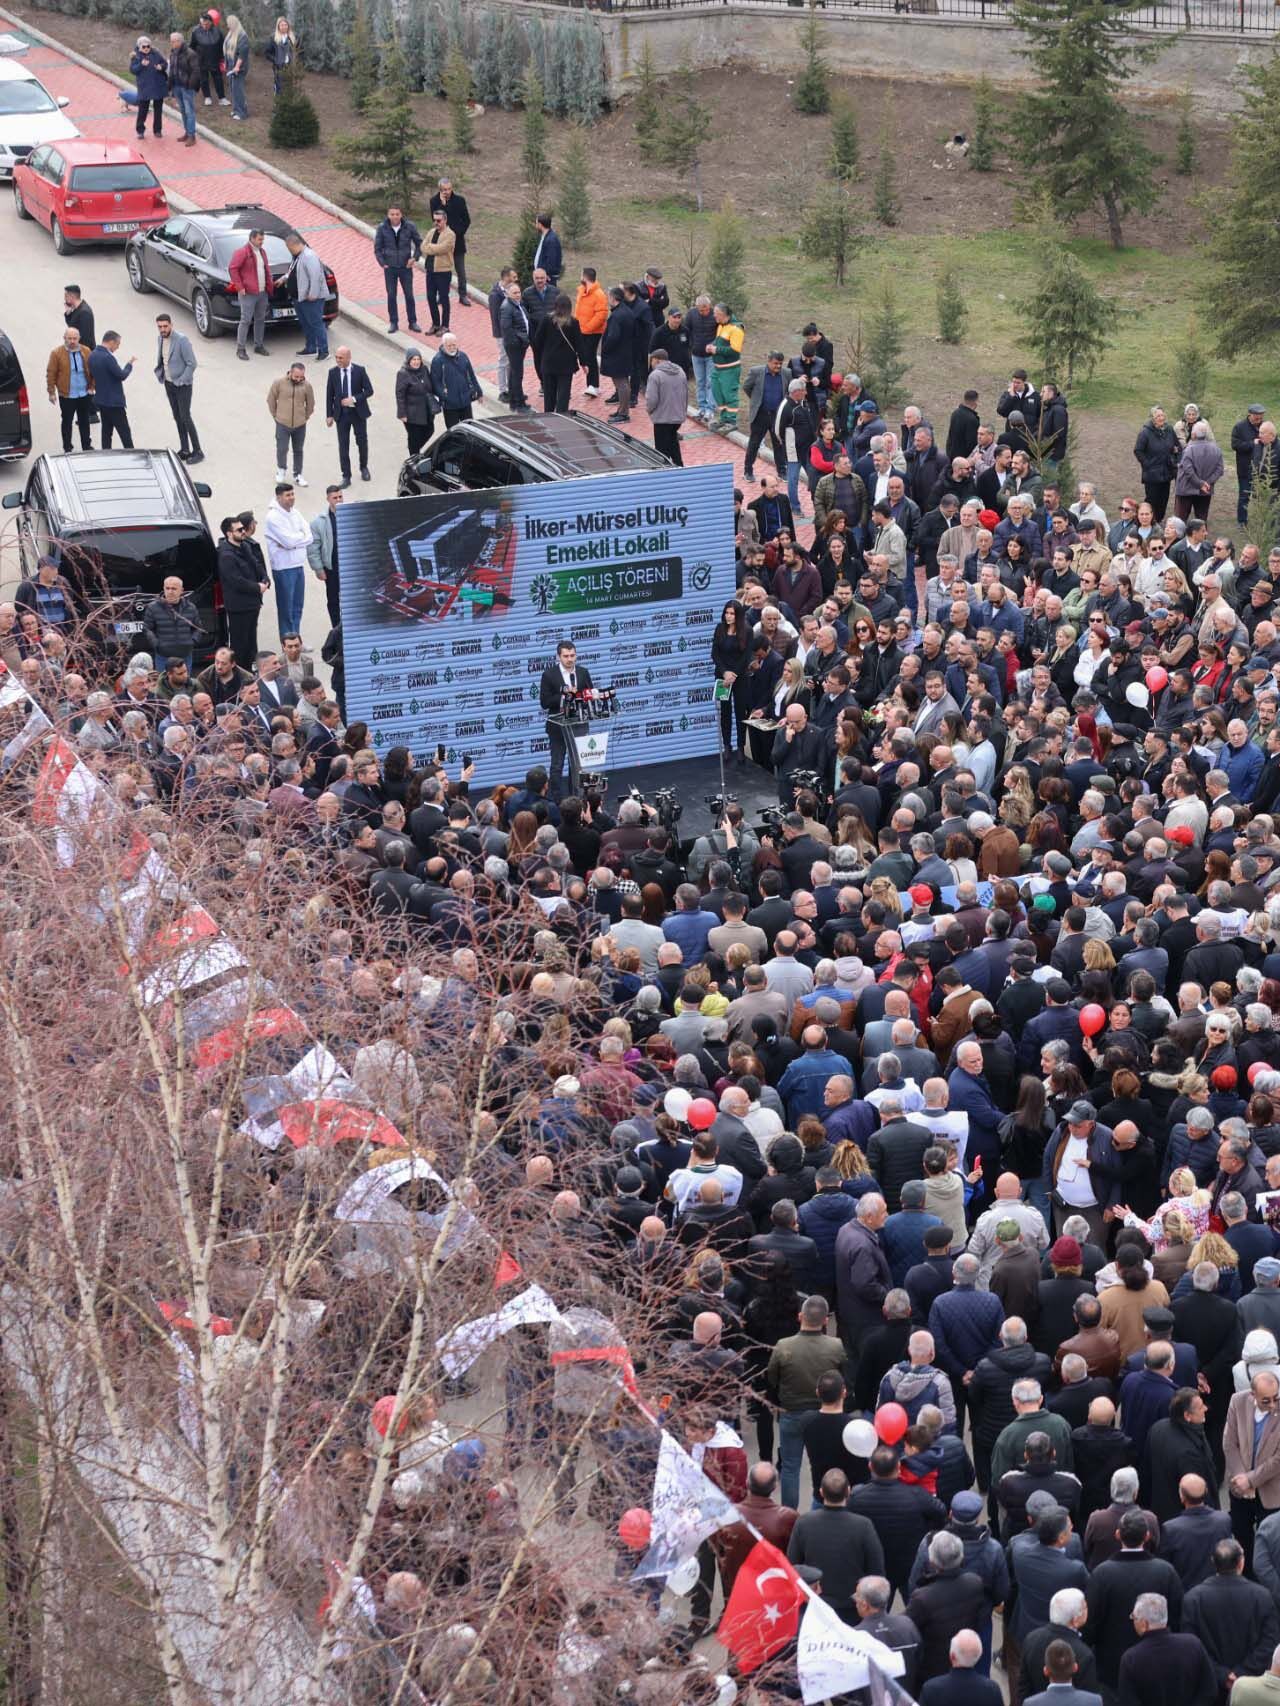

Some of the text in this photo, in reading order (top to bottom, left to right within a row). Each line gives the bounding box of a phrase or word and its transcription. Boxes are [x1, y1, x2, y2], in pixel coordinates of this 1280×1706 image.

[525, 505, 689, 540] İlker-Mürsel Uluç
[547, 530, 670, 564] Emekli Lokali
[567, 572, 613, 595] AÇILIŞ
[616, 562, 669, 587] TÖRENİ
